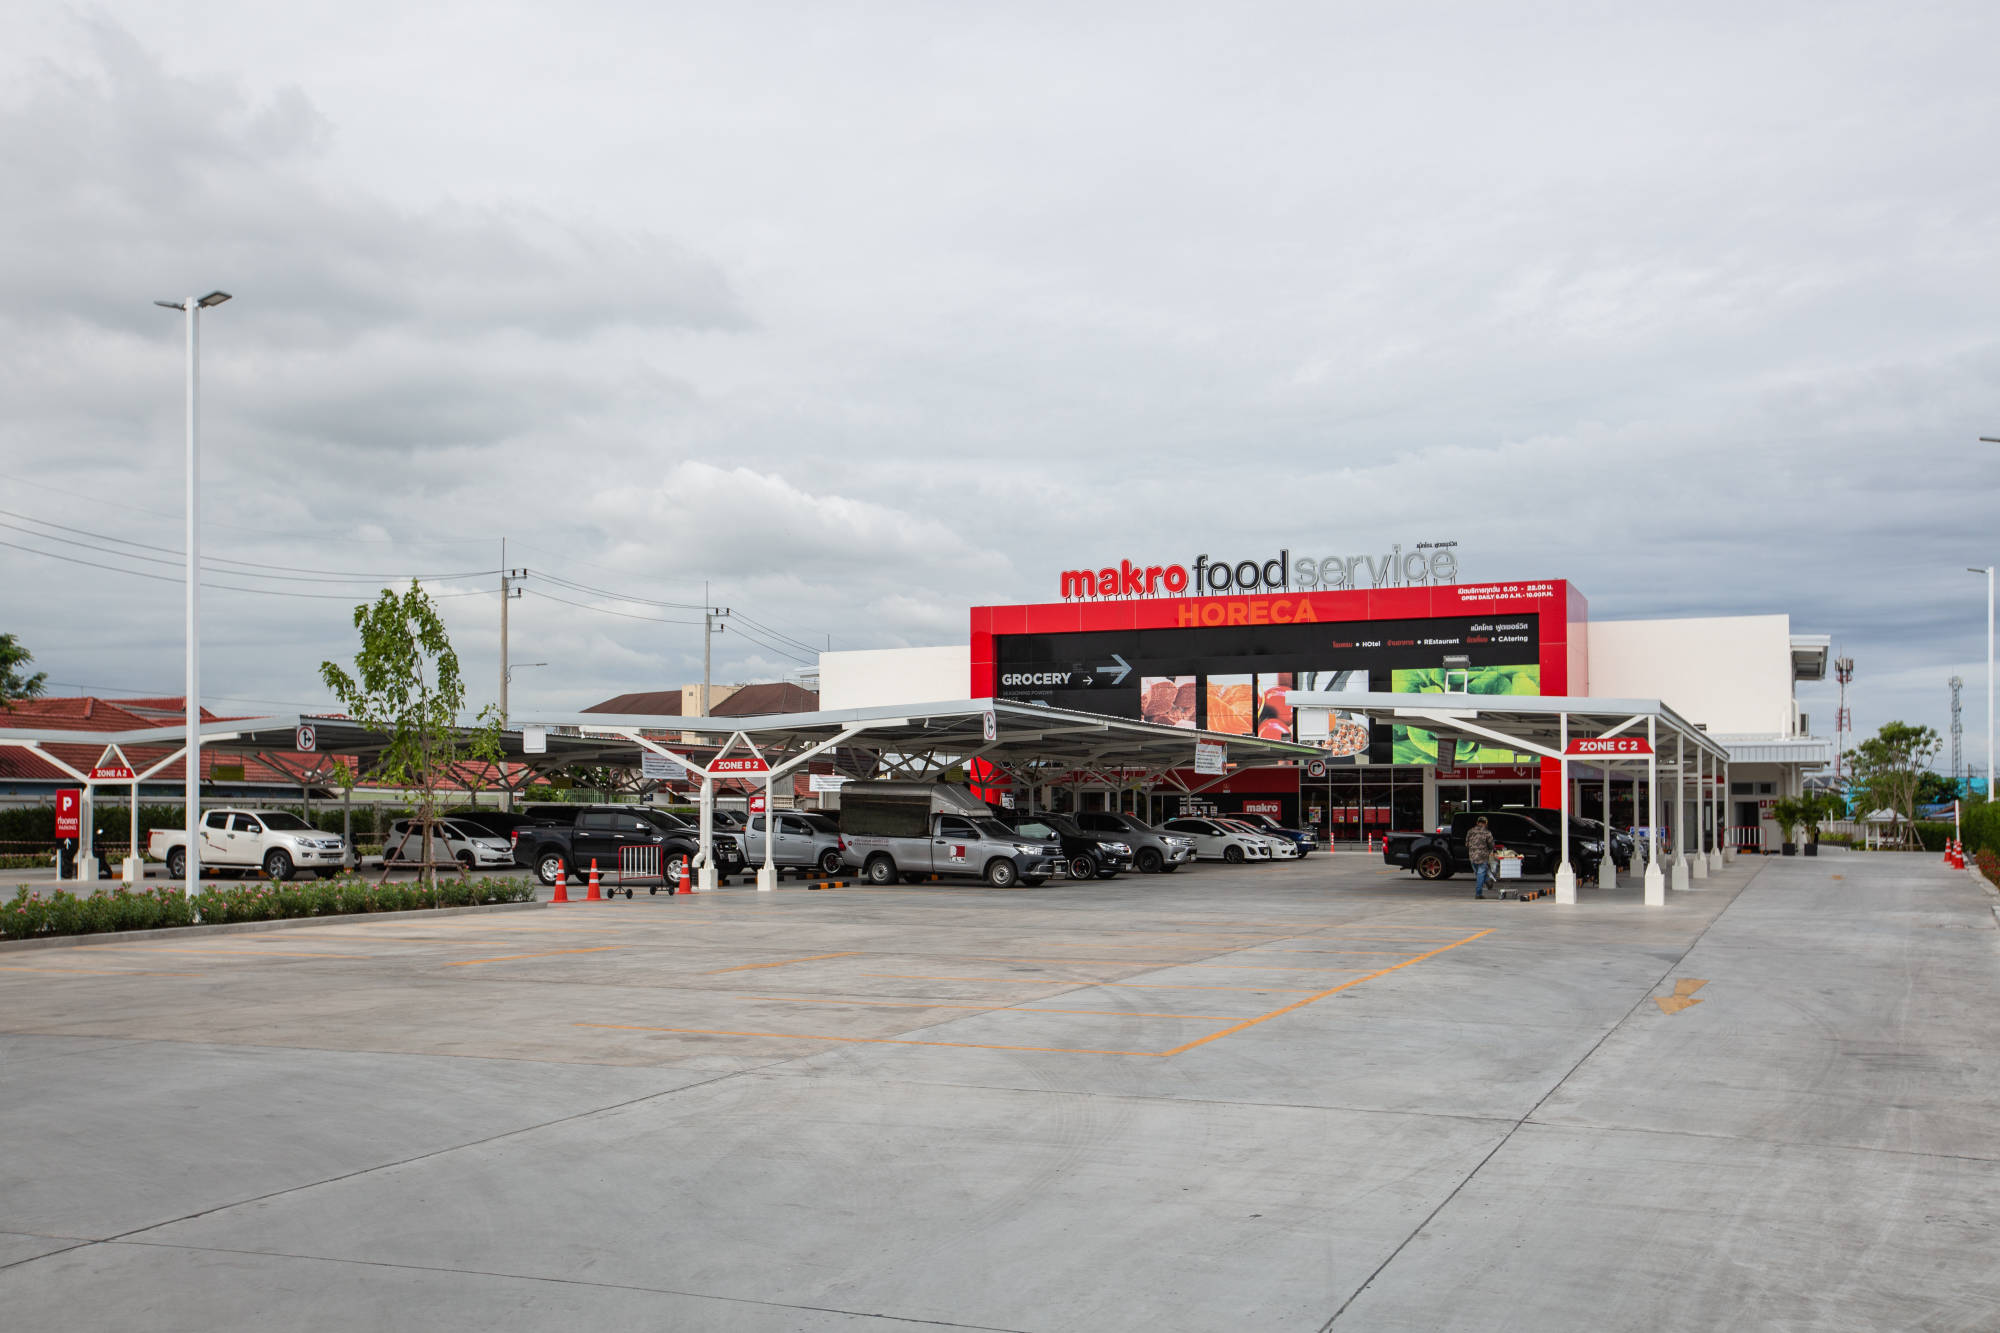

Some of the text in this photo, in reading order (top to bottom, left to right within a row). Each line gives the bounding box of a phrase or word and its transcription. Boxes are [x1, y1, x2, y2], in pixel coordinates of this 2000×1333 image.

[1060, 544, 1458, 598] makro food service
[1178, 599, 1318, 627] HORECA
[1362, 640, 1381, 648] HOtel
[1498, 635, 1528, 643] CAtering
[1001, 672, 1072, 685] GROCERY
[1579, 741, 1638, 751] ZONE C 2
[718, 761, 759, 769] ZONE B 2
[97, 769, 127, 777] ZONE A 2
[63, 797, 72, 811] P
[1246, 802, 1278, 813] makro
